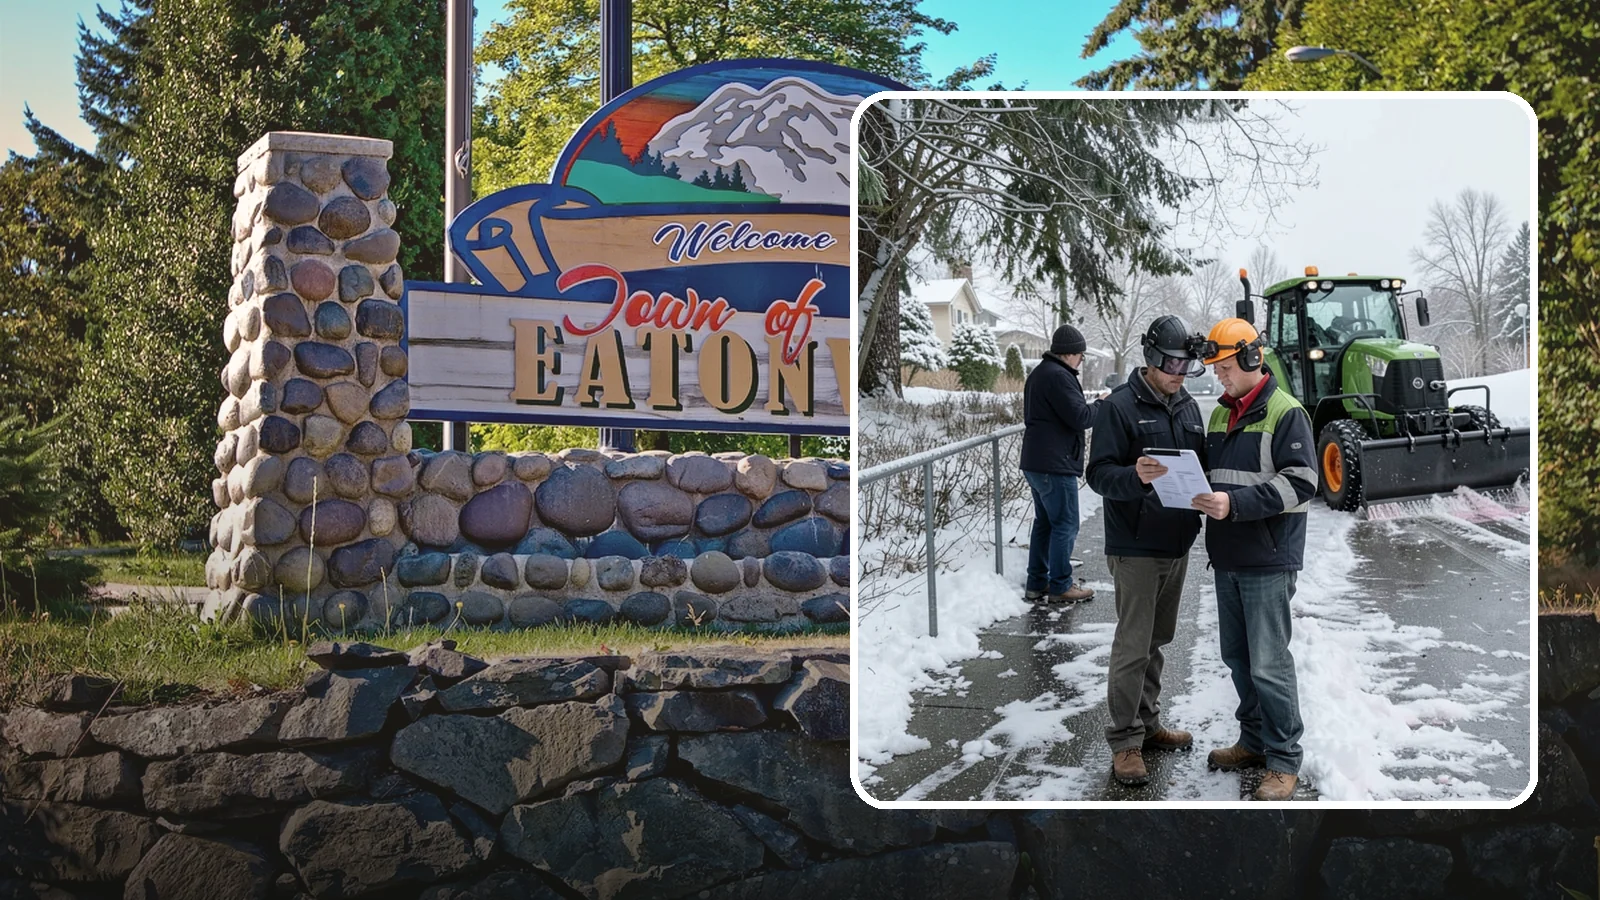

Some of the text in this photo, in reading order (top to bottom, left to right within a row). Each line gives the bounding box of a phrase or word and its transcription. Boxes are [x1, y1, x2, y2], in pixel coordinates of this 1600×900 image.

[653, 220, 836, 262] Welcome
[557, 264, 825, 365] Town of
